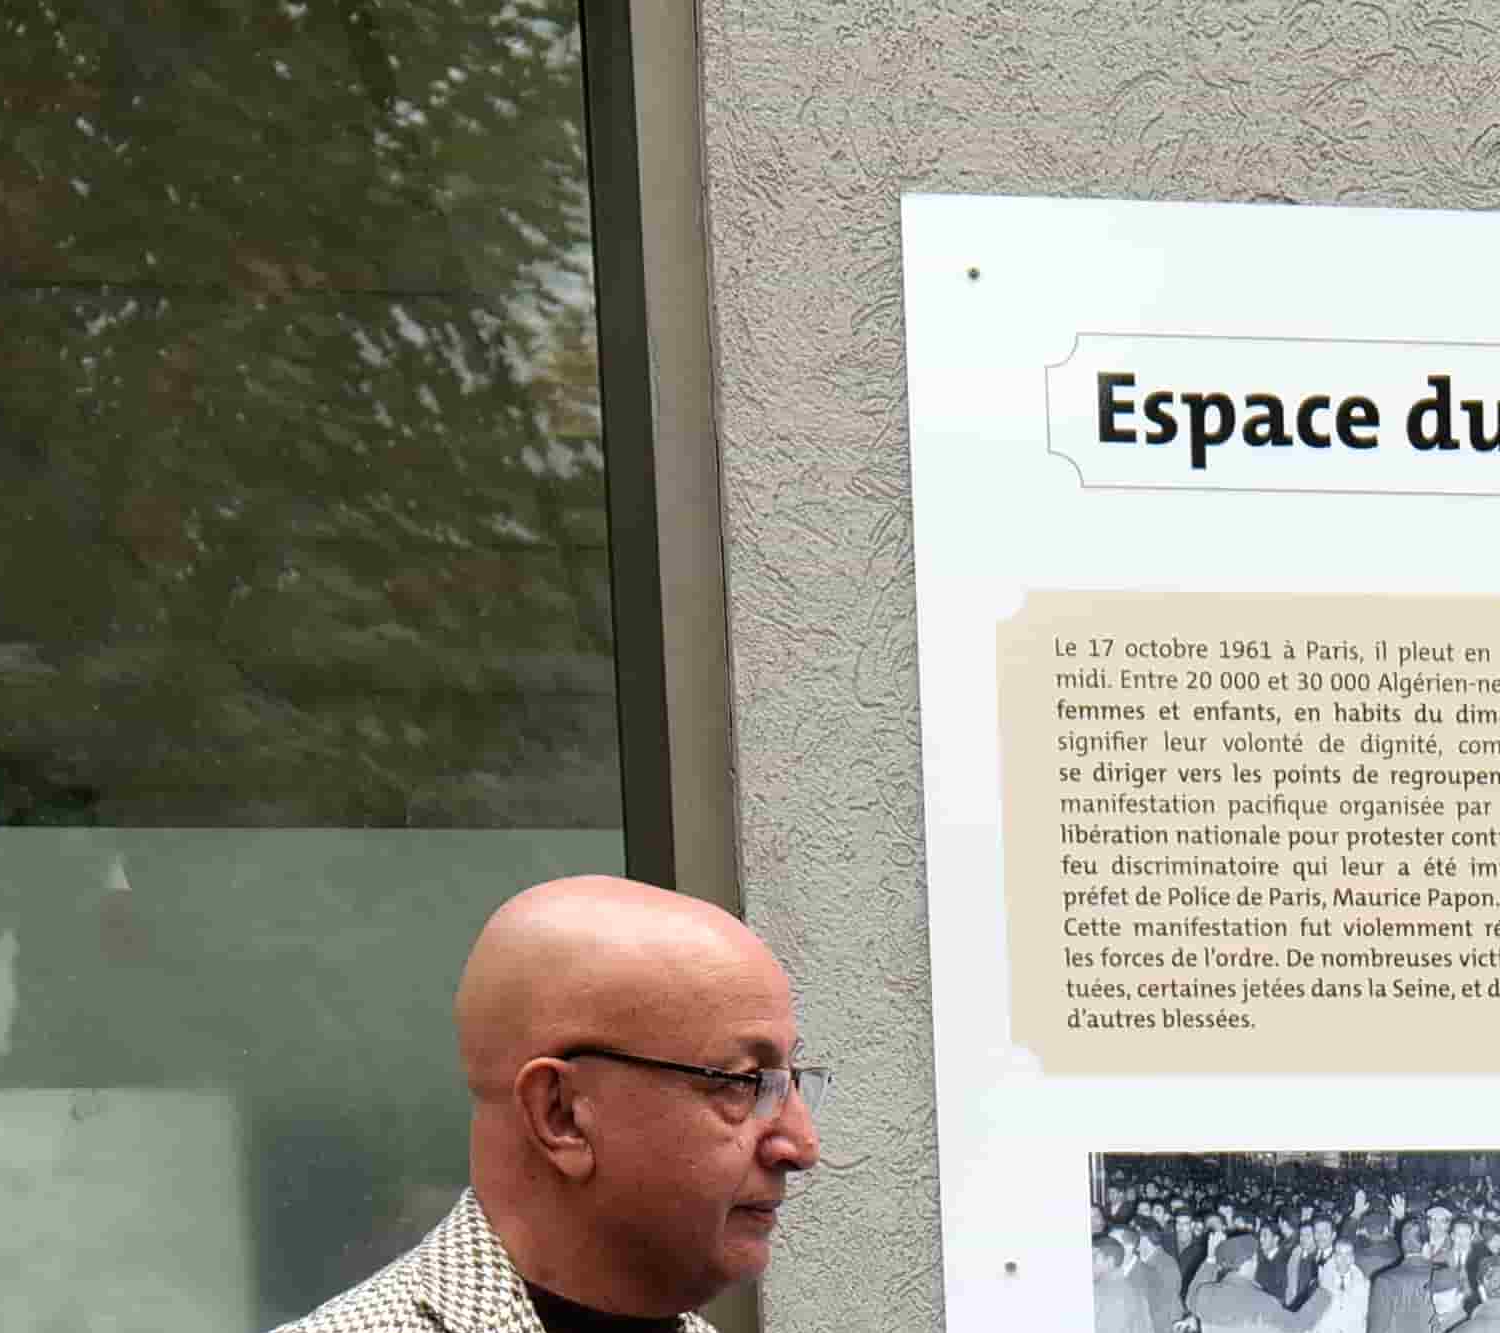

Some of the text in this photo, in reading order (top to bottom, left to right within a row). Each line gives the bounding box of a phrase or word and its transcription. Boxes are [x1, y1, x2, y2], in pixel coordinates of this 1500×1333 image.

[1096, 371, 1381, 470] Espace
[1055, 637, 1076, 656] Le
[1088, 638, 1113, 656] 17
[1124, 637, 1207, 658] octobre
[1219, 640, 1271, 659] 1961
[1283, 639, 1295, 659] à
[1306, 640, 1363, 664] Paris,
[1375, 639, 1386, 660] il
[1398, 640, 1454, 667] pleut
[1464, 647, 1489, 662] en
[1056, 698, 1145, 720] femmes
[1158, 701, 1180, 720] et
[1193, 700, 1280, 724] enfants,
[1294, 706, 1320, 722] en
[1333, 701, 1401, 722] habits
[1414, 703, 1442, 723] du
[1057, 730, 1148, 757] signifier
[1163, 730, 1206, 752] leur
[1222, 731, 1302, 752] volonté
[1318, 733, 1344, 752] de
[1360, 733, 1442, 760] dignité,
[1059, 767, 1081, 782] se
[1092, 761, 1167, 788] diriger
[1177, 767, 1221, 782] vers
[1232, 762, 1261, 783] les
[1273, 763, 1340, 789] points
[1352, 763, 1378, 784] de
[1059, 792, 1214, 814] manifestation
[1227, 793, 1327, 820] pacifique
[1339, 795, 1444, 821] organisée
[1456, 801, 1491, 821] par
[1059, 823, 1168, 844] libération
[1175, 823, 1280, 845] nationale
[1288, 830, 1339, 851] pour
[1345, 826, 1444, 851] protester
[1061, 854, 1098, 875] feu
[1111, 854, 1279, 875] discriminatoire
[1292, 855, 1327, 881] qui
[1341, 855, 1384, 876] leur
[1397, 861, 1410, 876] a
[1423, 856, 1456, 876] été
[1063, 885, 1500, 912] préfet de Police de Paris, Maurice Papon.
[1063, 917, 1121, 936] Cette
[1133, 916, 1286, 936] manifestation
[1300, 916, 1331, 936] fut
[1343, 916, 1473, 936] violemment
[1064, 946, 1093, 967] les
[1099, 946, 1164, 967] forces
[1171, 947, 1197, 967] de
[1203, 946, 1279, 967] l'ordre.
[1286, 948, 1314, 967] De
[1320, 947, 1452, 968] nombreuses
[1065, 978, 1130, 1000] tuées,
[1136, 977, 1236, 998] certaines
[1241, 977, 1305, 1003] jetées
[1310, 977, 1362, 997] dans
[1367, 977, 1387, 997] la
[1392, 978, 1455, 1000] Seine,
[1461, 979, 1482, 997] et
[1067, 1007, 1255, 1028] d'autres blessées.
